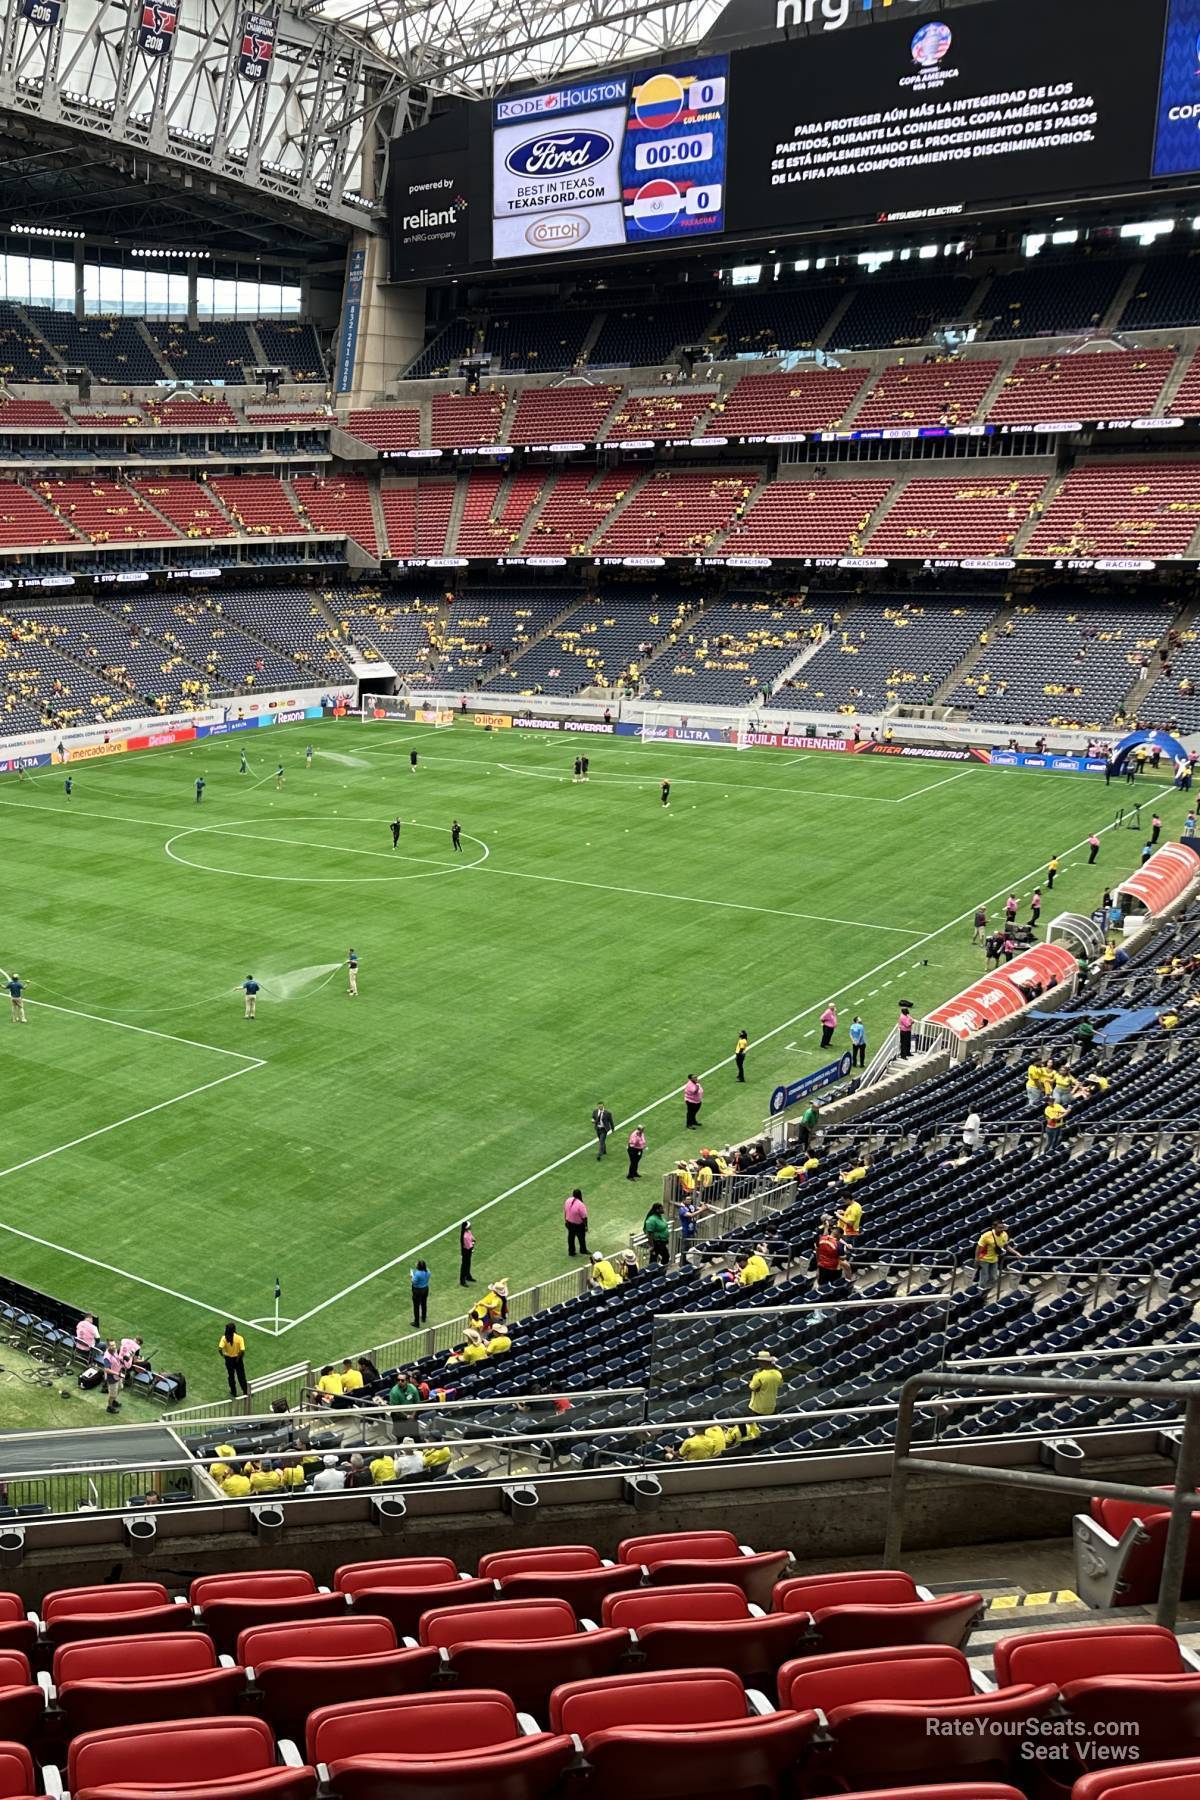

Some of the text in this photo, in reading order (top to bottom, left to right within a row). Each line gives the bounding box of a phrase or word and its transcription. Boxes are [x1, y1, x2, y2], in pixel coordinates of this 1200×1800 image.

[31, 4, 51, 21] 2016
[776, 0, 849, 30] nrg
[247, 22, 274, 36] CHAMPIONS
[144, 35, 164, 50] 2018
[245, 62, 262, 77] 2019
[899, 75, 920, 86] COPA
[702, 85, 713, 102] 0
[794, 82, 1073, 136] PARA PROTEGER AÚN MÁS LA INTEGRIDAD DE LOS
[683, 112, 721, 125] COLOMBIA
[776, 96, 1094, 154] PARTIDOS, DURANTE LA CONMEBOL COPA AMÉRICA 2024
[771, 112, 1098, 170] SE ESTÁ IMPLEMENTANDO EL PROCEDIMIENTO DE 3 PASOS
[526, 137, 592, 172] Ford
[646, 140, 702, 165] 00:00
[771, 130, 1095, 185] DE LA FIFA PARA COMPORTAMIENTOS DISCRIMINATORIOS.
[409, 179, 454, 195] powered by
[517, 176, 595, 198] BEST IN TEXAS
[508, 187, 605, 210] TEXASFORD.COM
[697, 192, 709, 209] 0
[403, 206, 457, 230] reliant
[887, 205, 962, 221] MITSUBISHI ELECTRIC
[403, 230, 457, 244] an NRG company
[816, 559, 837, 567] STOP
[278, 711, 304, 724] Rexona
[483, 716, 503, 725] libre
[513, 719, 560, 729] POWERADE
[564, 721, 614, 733] POWERADE
[674, 729, 710, 741] ULTRA
[72, 743, 122, 759] mercado libre
[781, 737, 846, 750] CENTENARIO
[872, 745, 963, 759] INTER RAPIDISIMO
